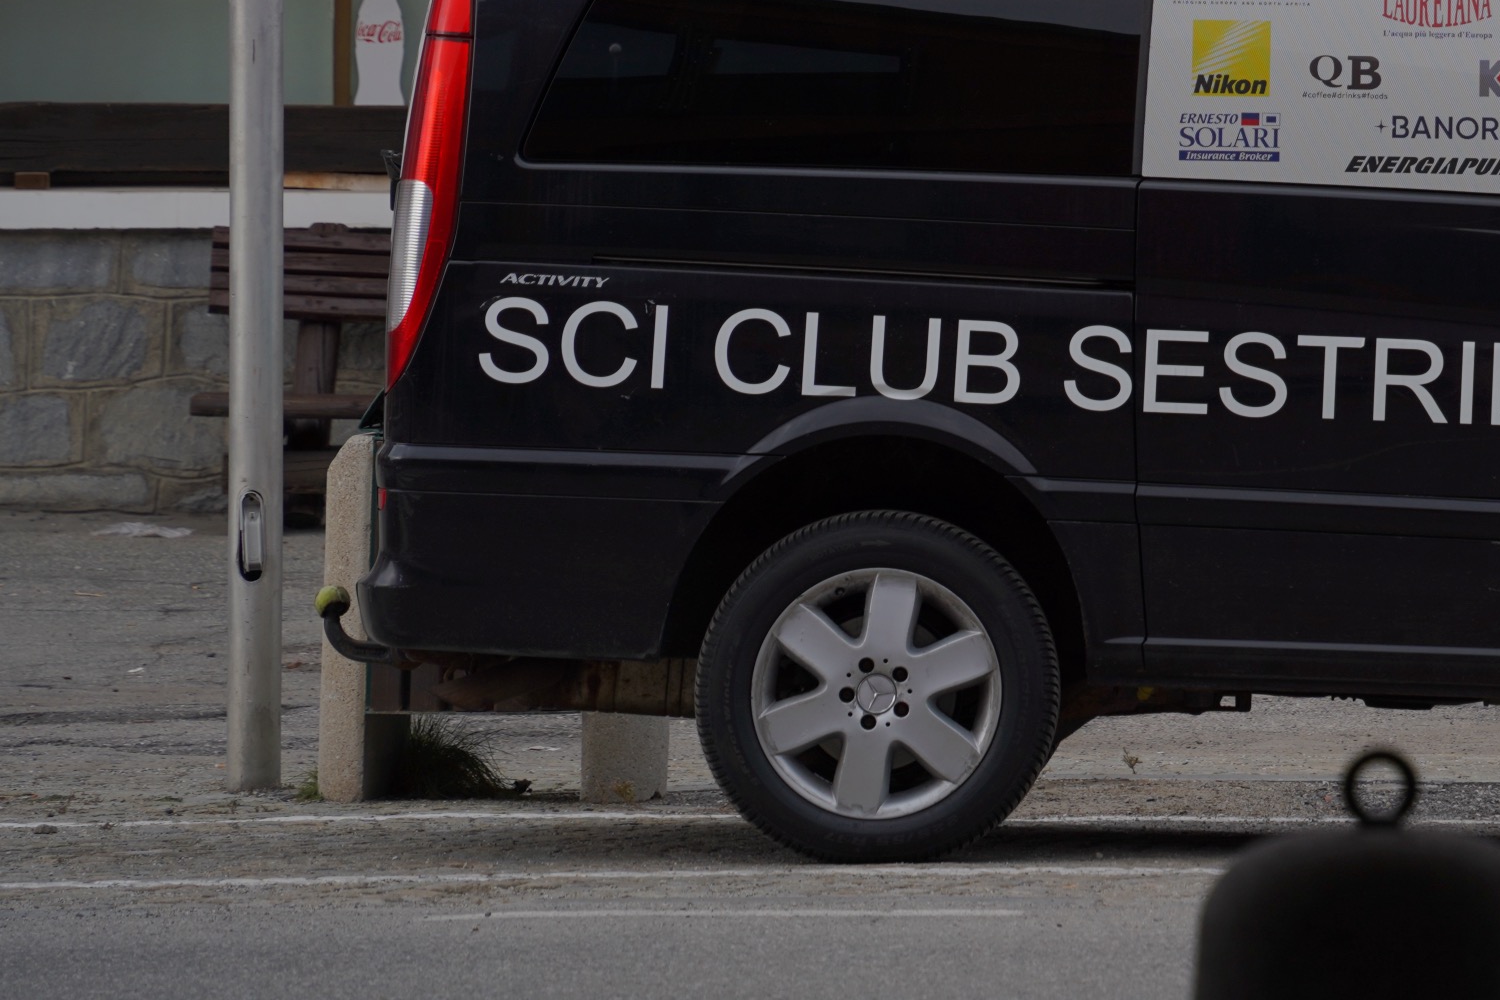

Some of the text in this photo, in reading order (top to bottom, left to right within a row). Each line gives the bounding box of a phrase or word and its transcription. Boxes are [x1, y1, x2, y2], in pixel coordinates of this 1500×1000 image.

[1383, 30, 1493, 40] L'acqua più leggera d'Europa
[1193, 74, 1268, 95] Nikon
[1179, 113, 1239, 125] ERNESTO
[1391, 115, 1500, 140] BANOR
[1179, 126, 1281, 148] SOLARI
[1185, 151, 1273, 161] Insurance Broker
[499, 273, 611, 288] ACTIVITY
[477, 296, 669, 390] SCI
[714, 307, 1021, 405] CLUB
